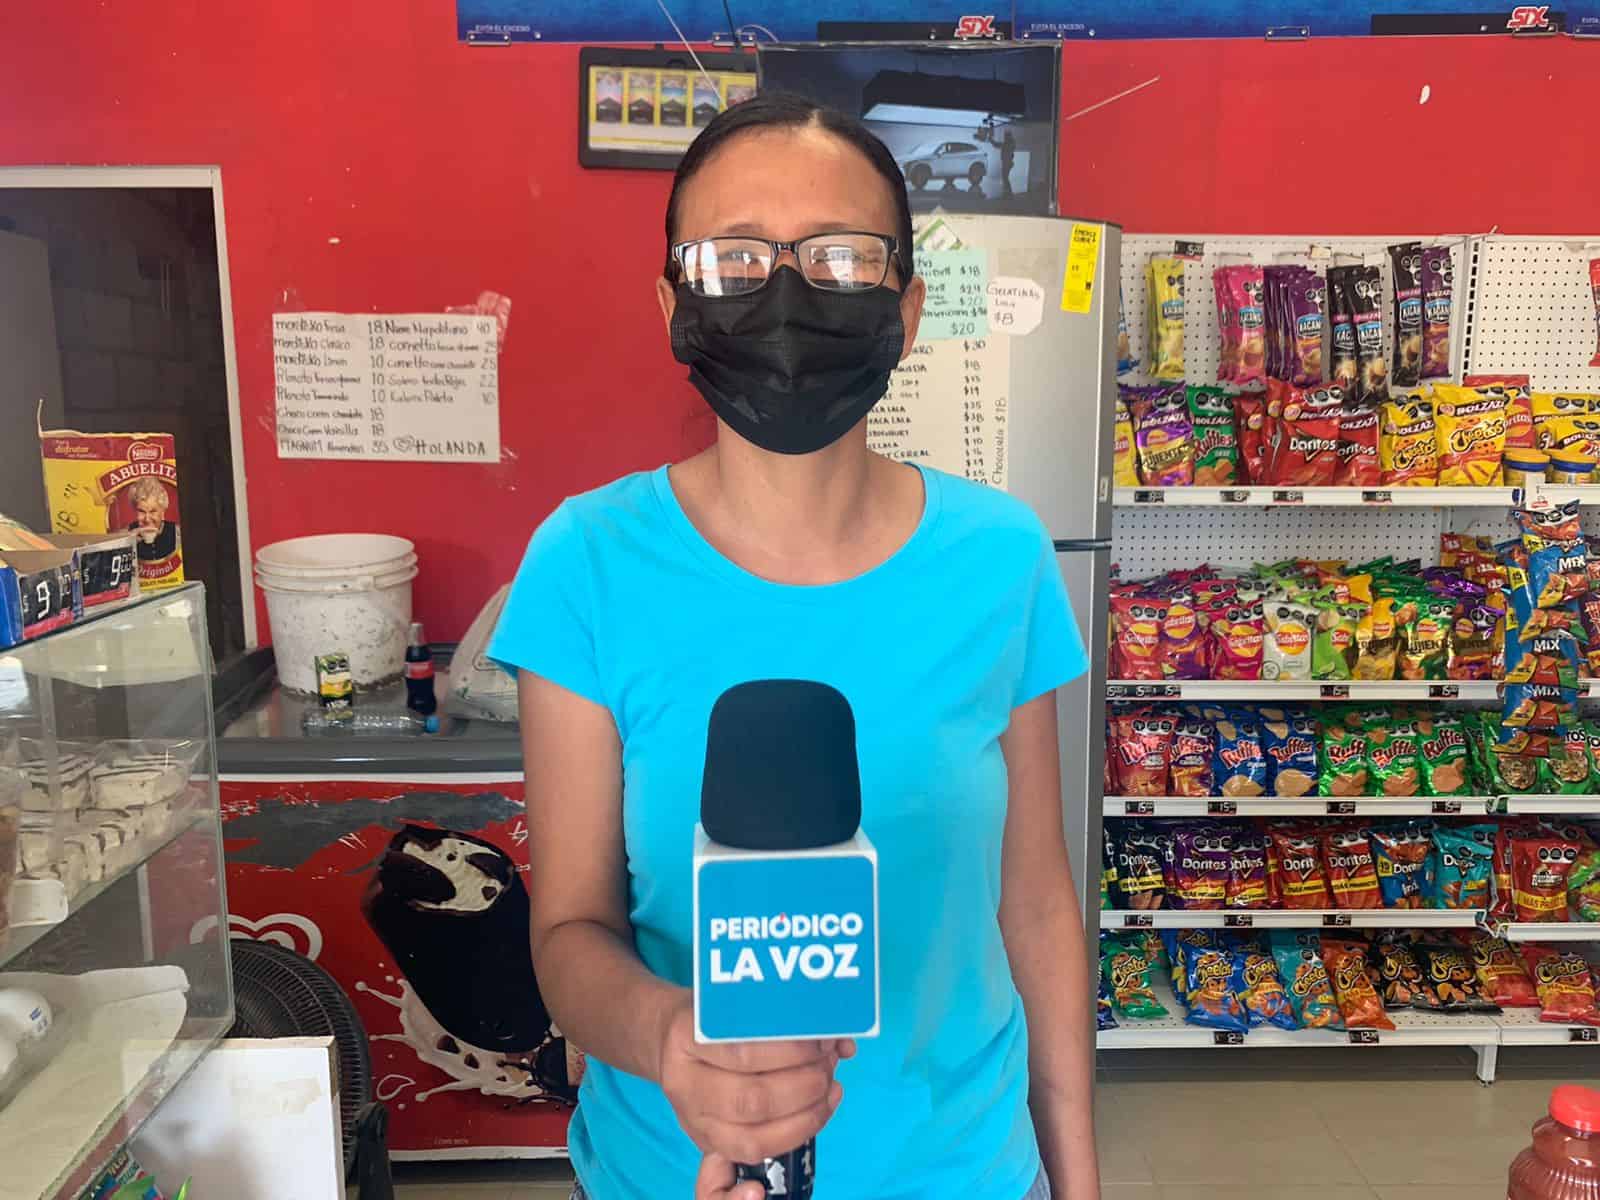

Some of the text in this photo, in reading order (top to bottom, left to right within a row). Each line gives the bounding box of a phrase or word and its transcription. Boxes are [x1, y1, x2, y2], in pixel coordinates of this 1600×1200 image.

[1508, 6, 1549, 28] SIX
[955, 16, 996, 38] SIX
[367, 320, 384, 335] 18
[951, 323, 976, 338] $20
[368, 336, 385, 351] 18
[371, 424, 385, 436] 18
[1289, 437, 1337, 453] Doritos
[139, 561, 174, 578] riginal
[1182, 856, 1227, 871] Doritos
[711, 912, 863, 940] PERIÓDICO
[711, 944, 860, 983] LA VOZ
